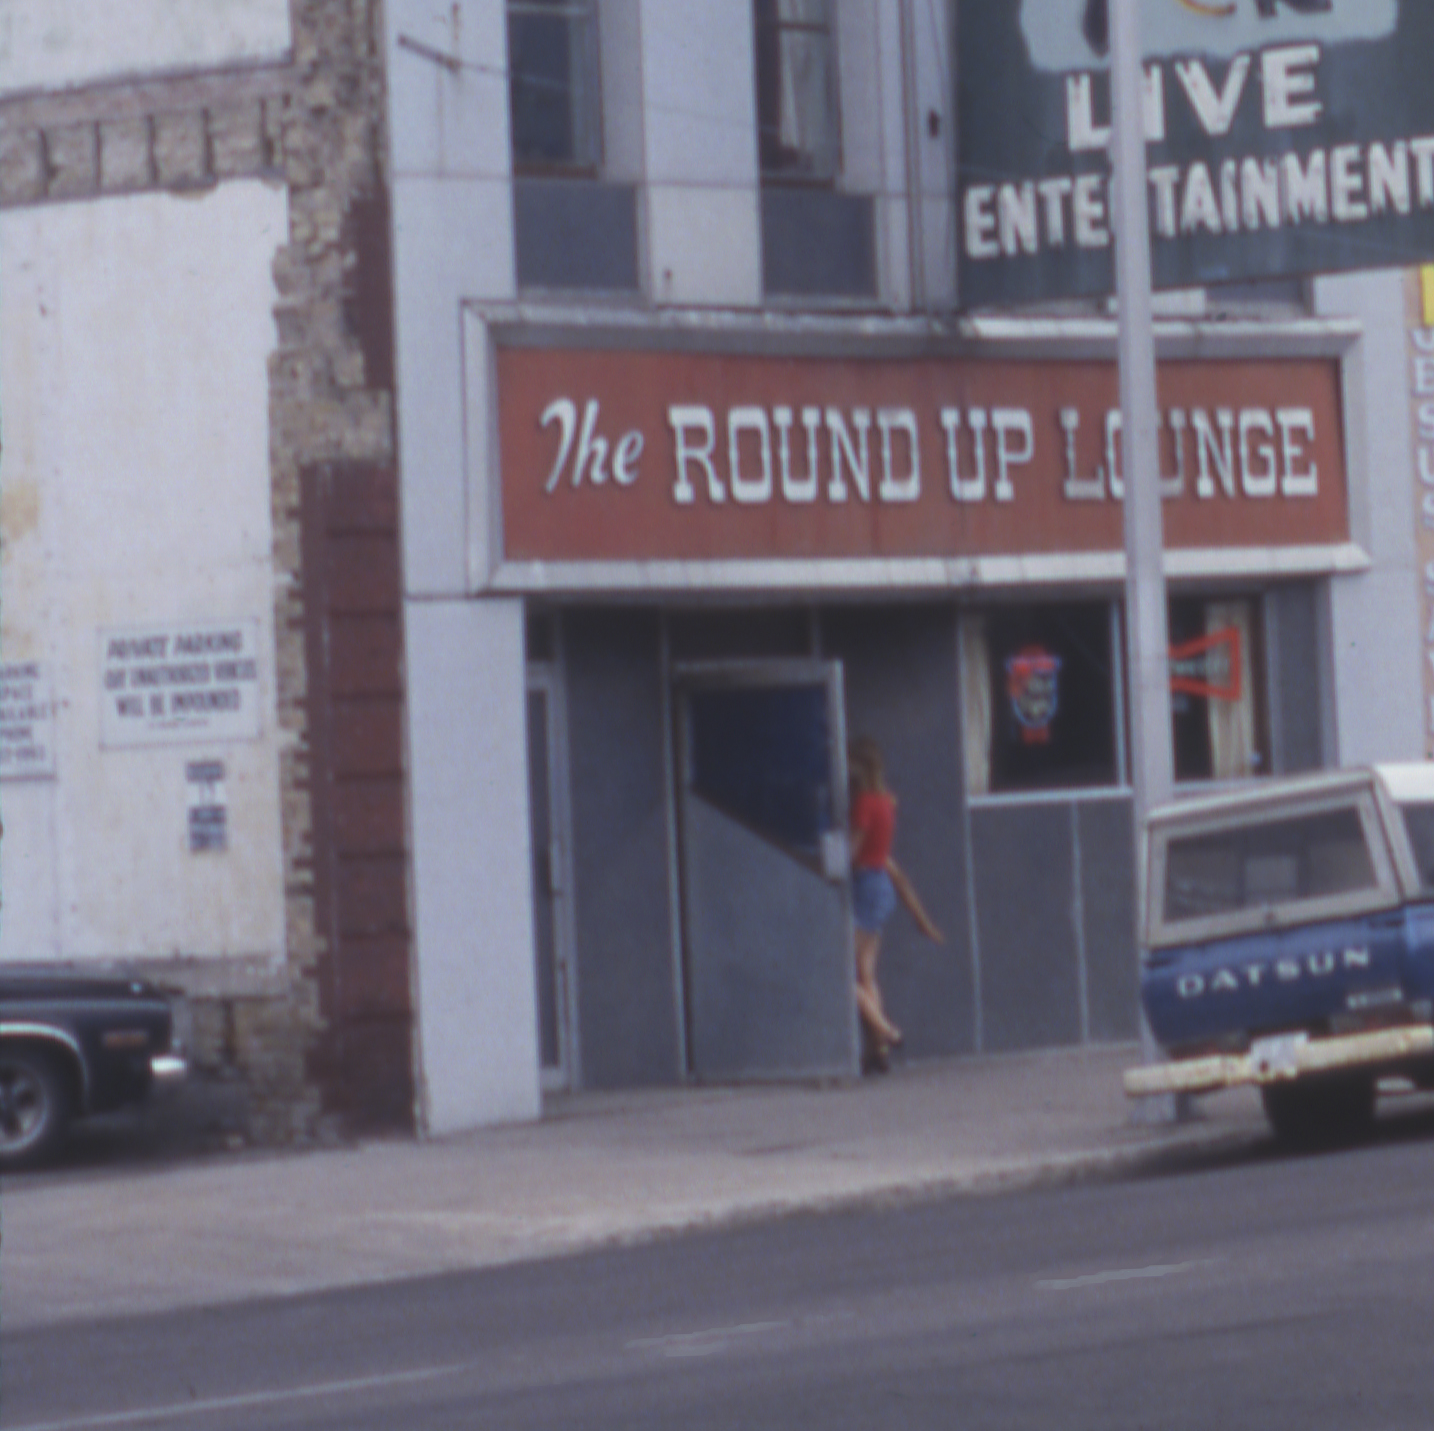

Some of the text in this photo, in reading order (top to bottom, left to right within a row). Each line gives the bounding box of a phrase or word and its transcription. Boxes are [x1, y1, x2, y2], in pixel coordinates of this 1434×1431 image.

[1066, 44, 1322, 152] LIVE
[540, 397, 645, 494] The
[668, 405, 921, 504] ROUND
[940, 406, 1034, 503] UP
[1177, 947, 1370, 997] DATSUN
